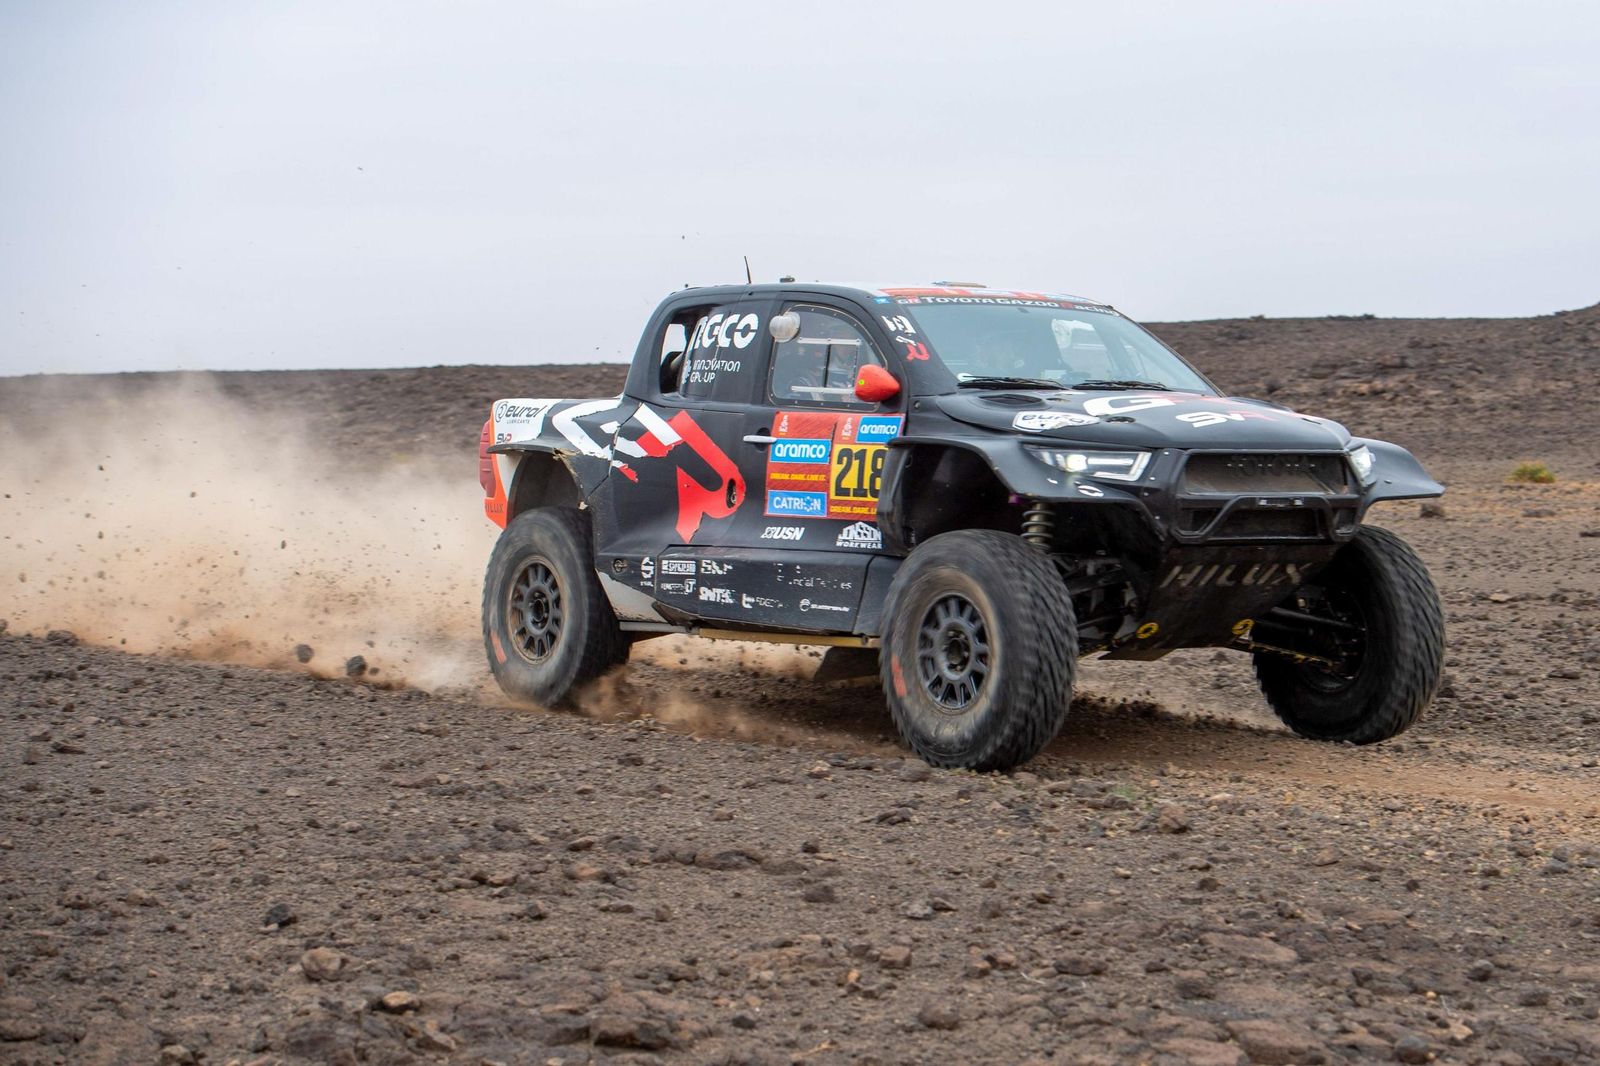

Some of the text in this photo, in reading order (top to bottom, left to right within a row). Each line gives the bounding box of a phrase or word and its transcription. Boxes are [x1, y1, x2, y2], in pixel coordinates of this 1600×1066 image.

[921, 296, 996, 305] TOYOTA
[996, 298, 1060, 308] GAZOO
[504, 404, 547, 419] eurol
[859, 423, 898, 435] aramco
[774, 443, 827, 459] aramco
[834, 447, 884, 499] 218
[772, 496, 822, 512] CATRION
[773, 526, 805, 541] USN
[835, 540, 883, 549] WORKWEAR
[1159, 562, 1314, 589] HILUX
